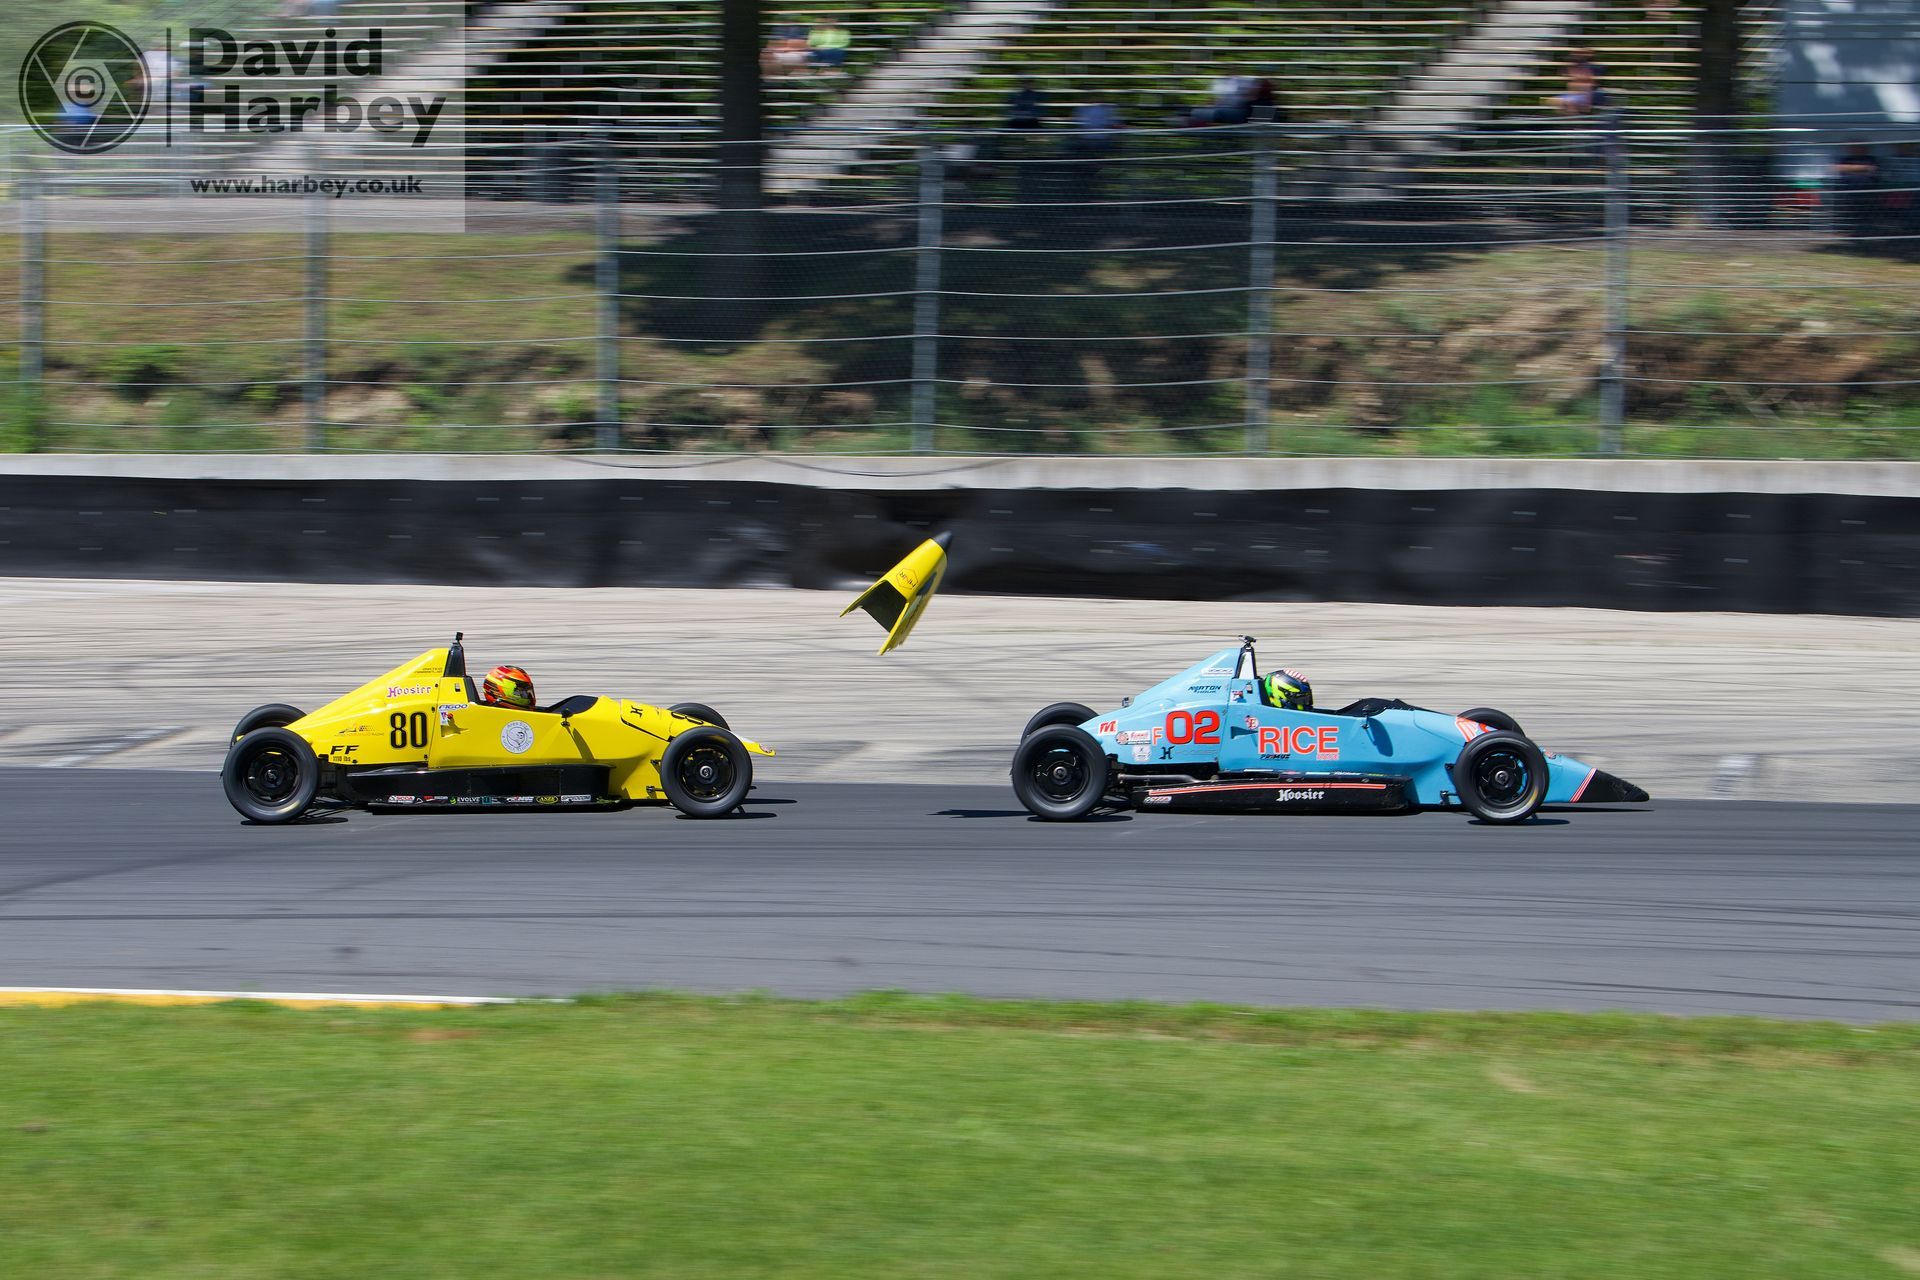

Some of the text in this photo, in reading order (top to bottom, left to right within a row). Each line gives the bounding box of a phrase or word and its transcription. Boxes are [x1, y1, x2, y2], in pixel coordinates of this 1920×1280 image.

[386, 684, 432, 698] Hoosier
[390, 712, 428, 749] 80
[1152, 710, 1220, 745] F 02
[330, 744, 360, 755] FF
[1259, 726, 1339, 754] RICE
[1276, 788, 1325, 802] Hoosier
